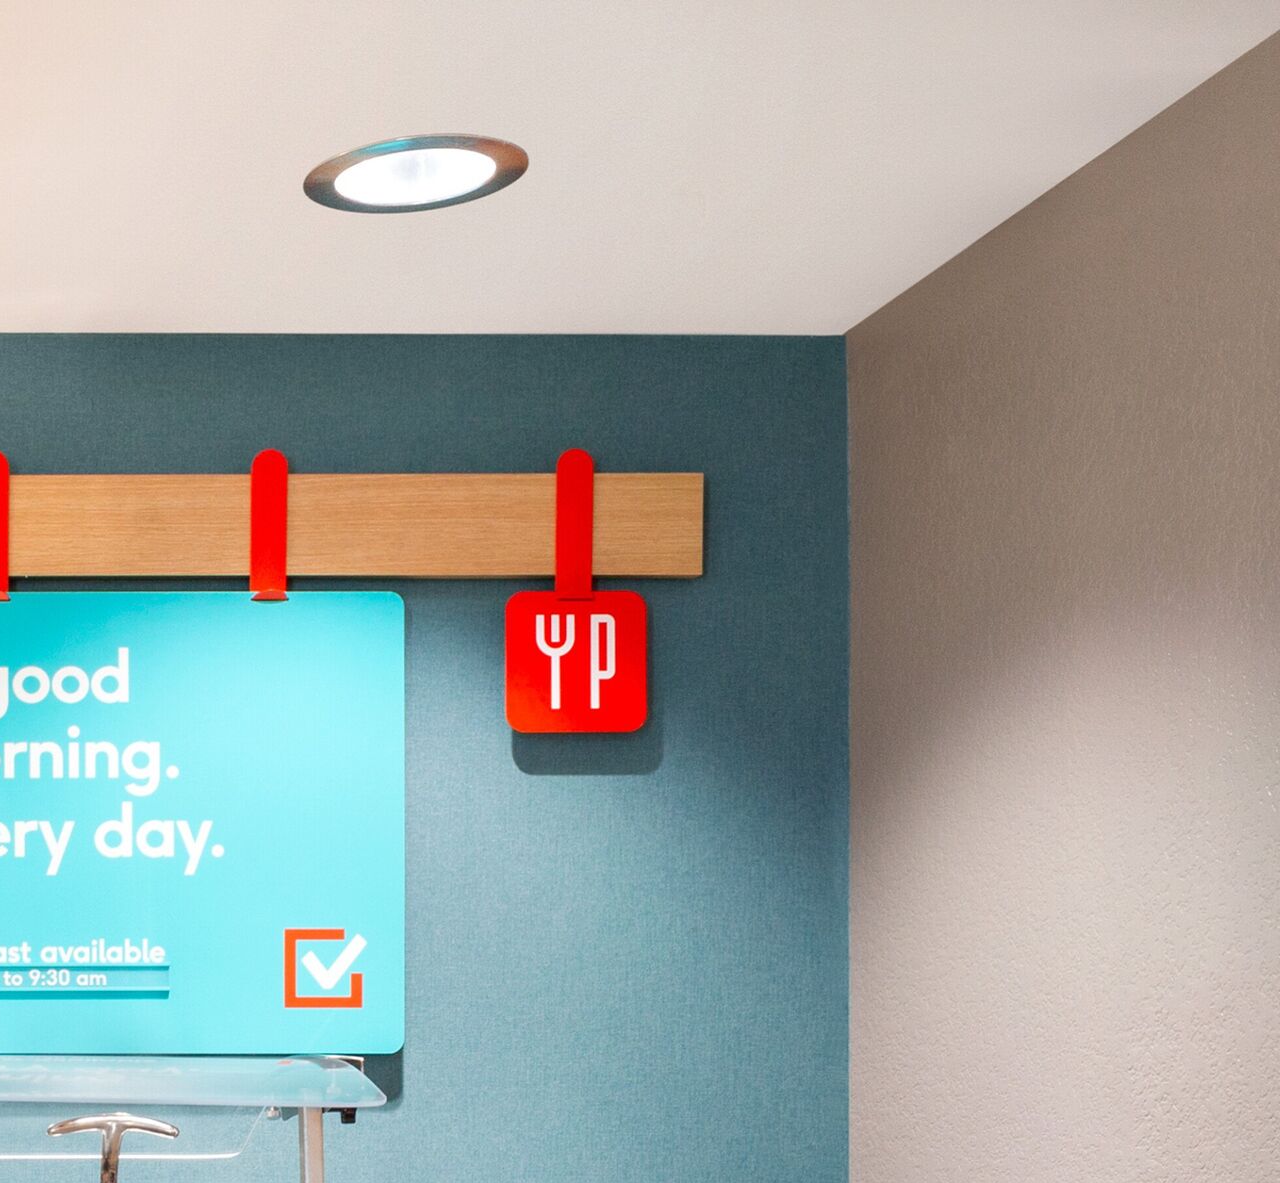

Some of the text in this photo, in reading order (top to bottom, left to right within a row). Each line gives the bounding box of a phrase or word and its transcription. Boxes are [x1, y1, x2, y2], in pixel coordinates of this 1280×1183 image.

[93, 801, 225, 876] day.
[40, 938, 166, 964] available
[3, 970, 23, 987] to
[29, 969, 71, 987] 9:30
[76, 973, 107, 987] am
